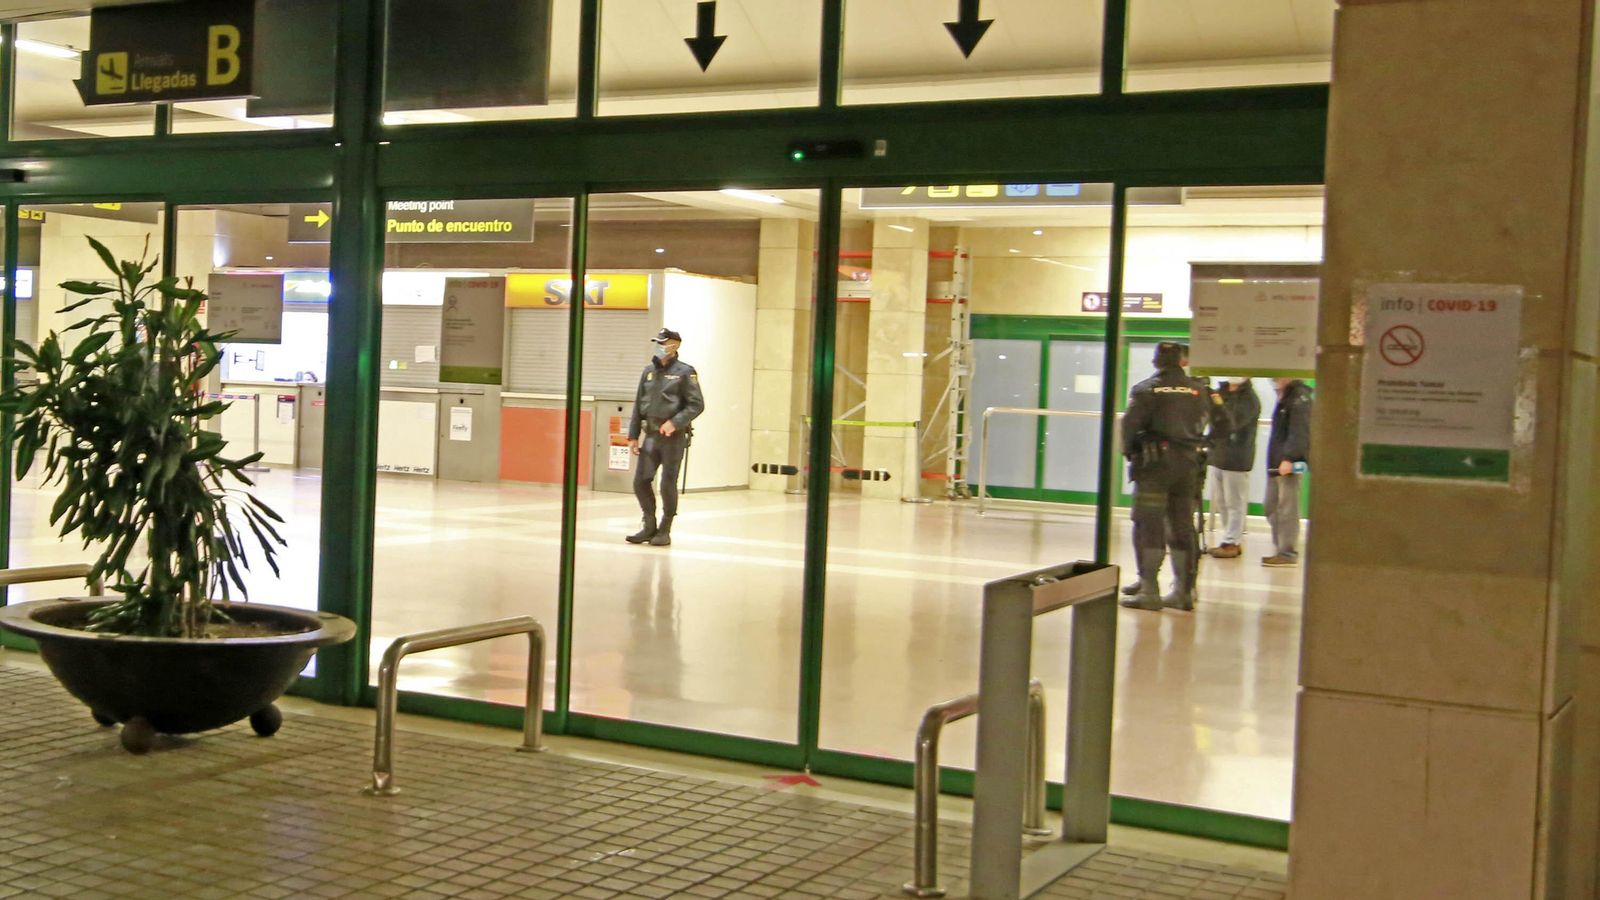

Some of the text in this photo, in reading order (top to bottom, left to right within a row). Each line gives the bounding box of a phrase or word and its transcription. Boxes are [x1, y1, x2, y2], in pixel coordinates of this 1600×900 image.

[207, 25, 240, 86] B
[131, 70, 197, 92] Llegadas
[387, 200, 454, 212] Meeting point
[387, 219, 513, 233] Punto de encuentro
[1380, 297, 1496, 312] info COVID-19
